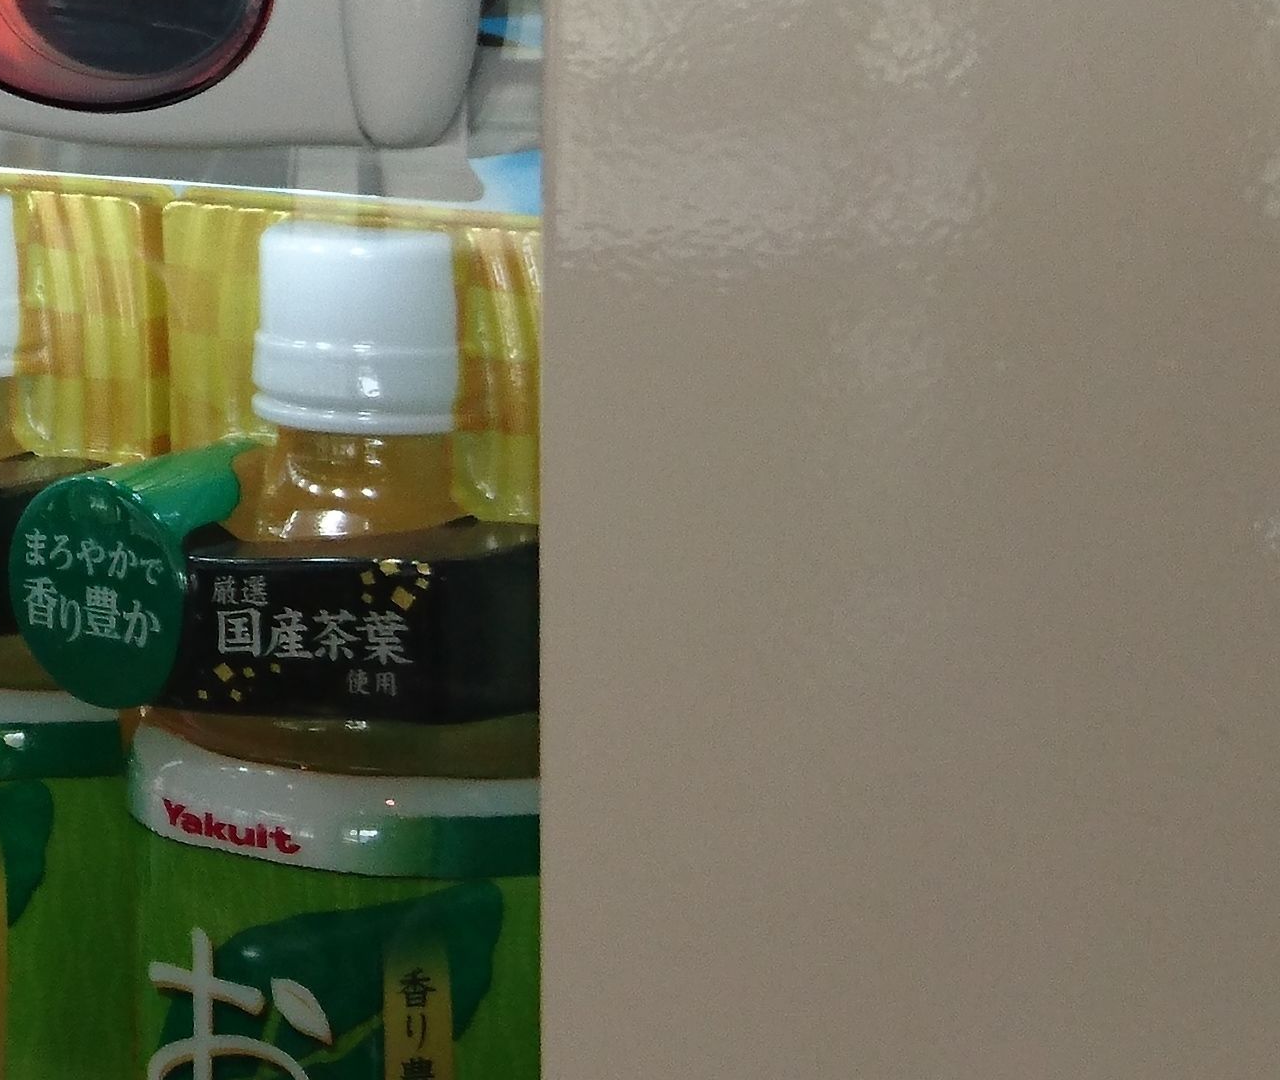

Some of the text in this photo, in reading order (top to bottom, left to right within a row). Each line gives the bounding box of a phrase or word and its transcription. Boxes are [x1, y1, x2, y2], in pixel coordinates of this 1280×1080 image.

[23, 528, 165, 587] まろやかで
[22, 576, 163, 648] 香り豊か
[211, 575, 269, 607] 厳選
[216, 606, 414, 666] 国産茶葉
[345, 667, 398, 697] 使用
[162, 797, 302, 856] Yakult
